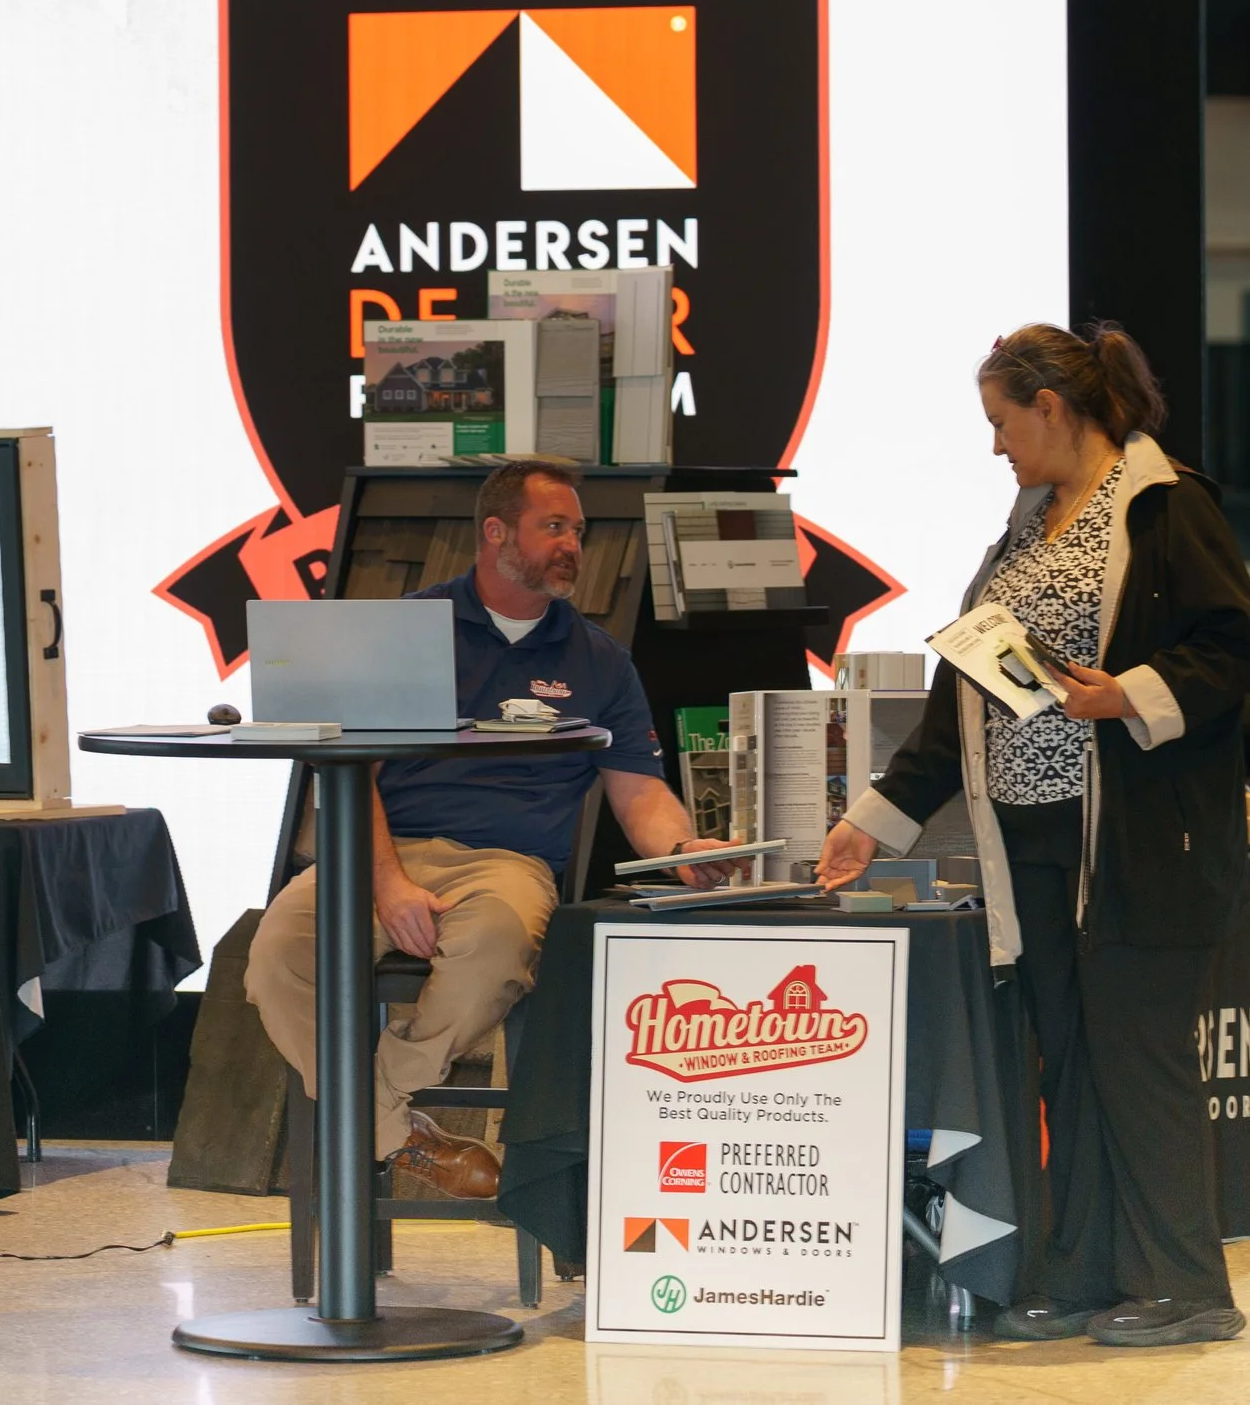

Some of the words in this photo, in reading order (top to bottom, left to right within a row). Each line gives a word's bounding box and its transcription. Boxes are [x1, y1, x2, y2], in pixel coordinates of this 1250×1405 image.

[350, 218, 699, 273] ANDERSEN
[630, 997, 846, 1055] Hometown
[683, 1052, 738, 1072] WINDOW
[741, 1052, 750, 1064] &
[753, 1045, 807, 1063] ROOFING
[810, 1043, 844, 1057] TEAM
[647, 1089, 672, 1103] We
[677, 1090, 735, 1108] Proudly
[740, 1092, 768, 1106] Use
[774, 1092, 810, 1109] Only
[814, 1093, 842, 1107] The
[659, 1106, 692, 1121] Best
[697, 1107, 751, 1124] Quality
[757, 1108, 829, 1124] Products.
[721, 1143, 820, 1168] PREFERRED
[662, 1177, 705, 1187] CORNING
[669, 1167, 705, 1178] OWENS
[720, 1171, 829, 1197] CONTRACTOR
[698, 1219, 853, 1244] ANDERSEN
[697, 1245, 772, 1256] WINDOWS
[783, 1247, 790, 1256] &
[801, 1247, 853, 1258] DOORS
[694, 1287, 826, 1307] JamesHardie
